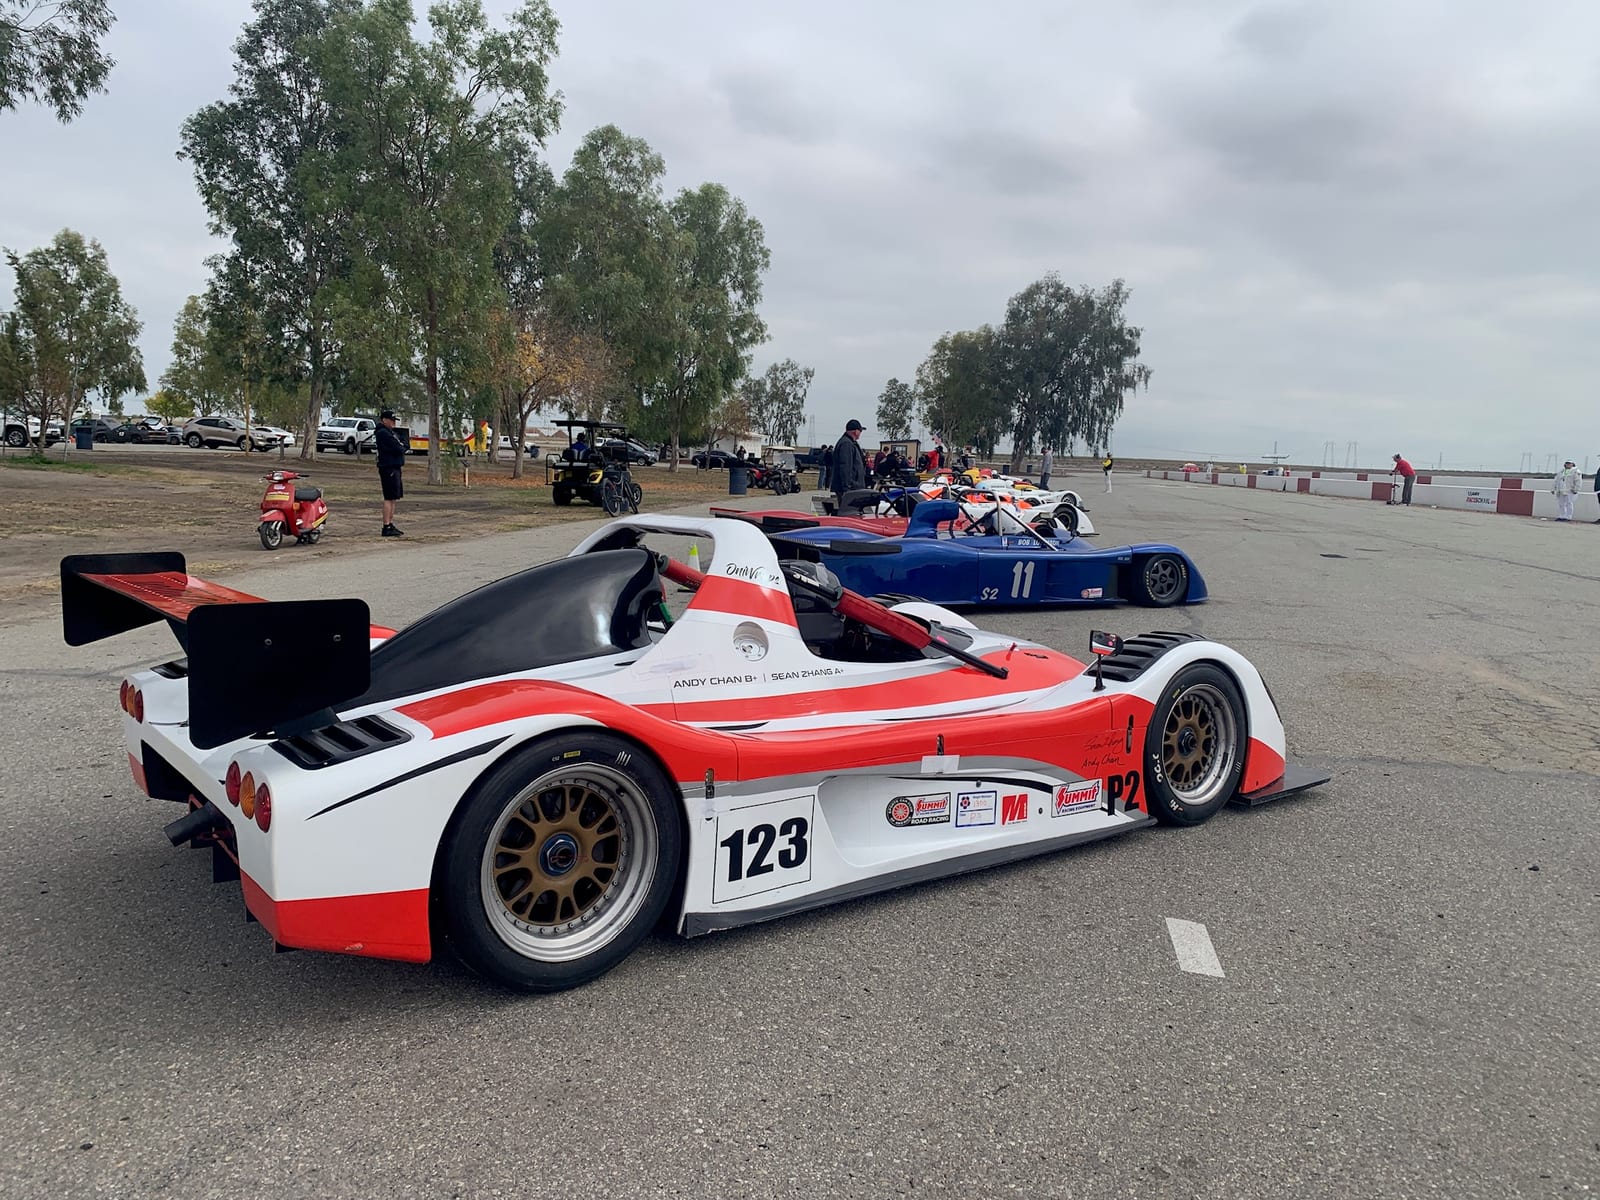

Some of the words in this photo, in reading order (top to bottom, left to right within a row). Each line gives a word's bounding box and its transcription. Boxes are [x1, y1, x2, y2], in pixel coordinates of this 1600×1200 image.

[980, 587, 999, 600] S2
[1011, 561, 1035, 599] 11
[673, 677, 706, 689] ANDY
[710, 675, 743, 686] CHAN
[771, 671, 800, 681] SEAN
[801, 668, 833, 678] ZHANG
[915, 797, 948, 814] SUMMIT
[1056, 782, 1099, 812] SUMMIT
[1107, 770, 1140, 816] P2
[720, 817, 808, 882] 123
